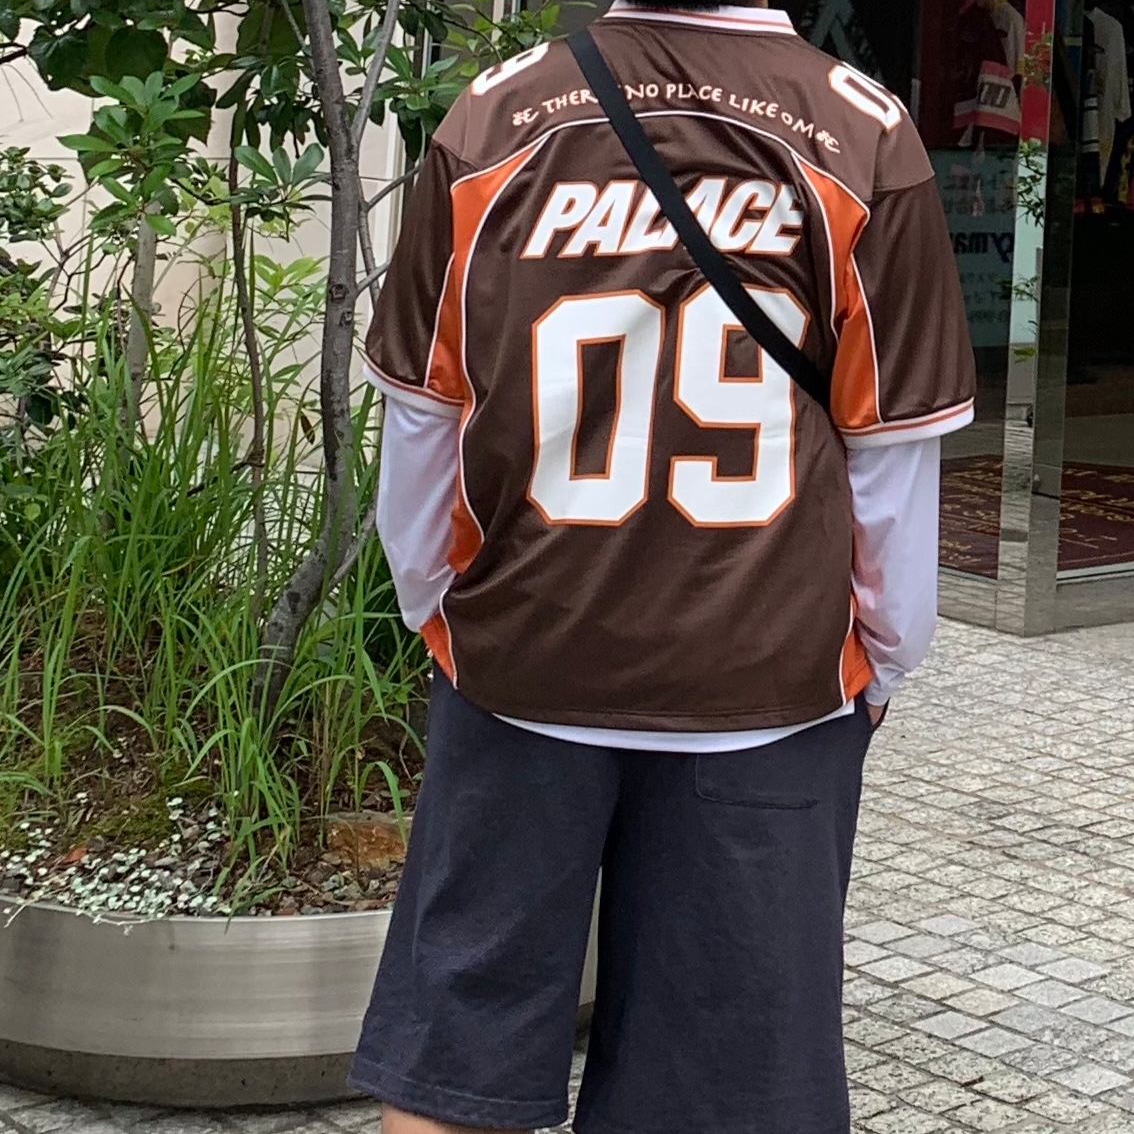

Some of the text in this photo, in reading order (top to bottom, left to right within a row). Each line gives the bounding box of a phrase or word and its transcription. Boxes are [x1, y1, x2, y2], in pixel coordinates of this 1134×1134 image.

[624, 83, 659, 100] NO
[666, 83, 723, 102] PLACE
[728, 94, 779, 118] LIKE
[781, 112, 814, 138] OM
[526, 282, 811, 528] 09
